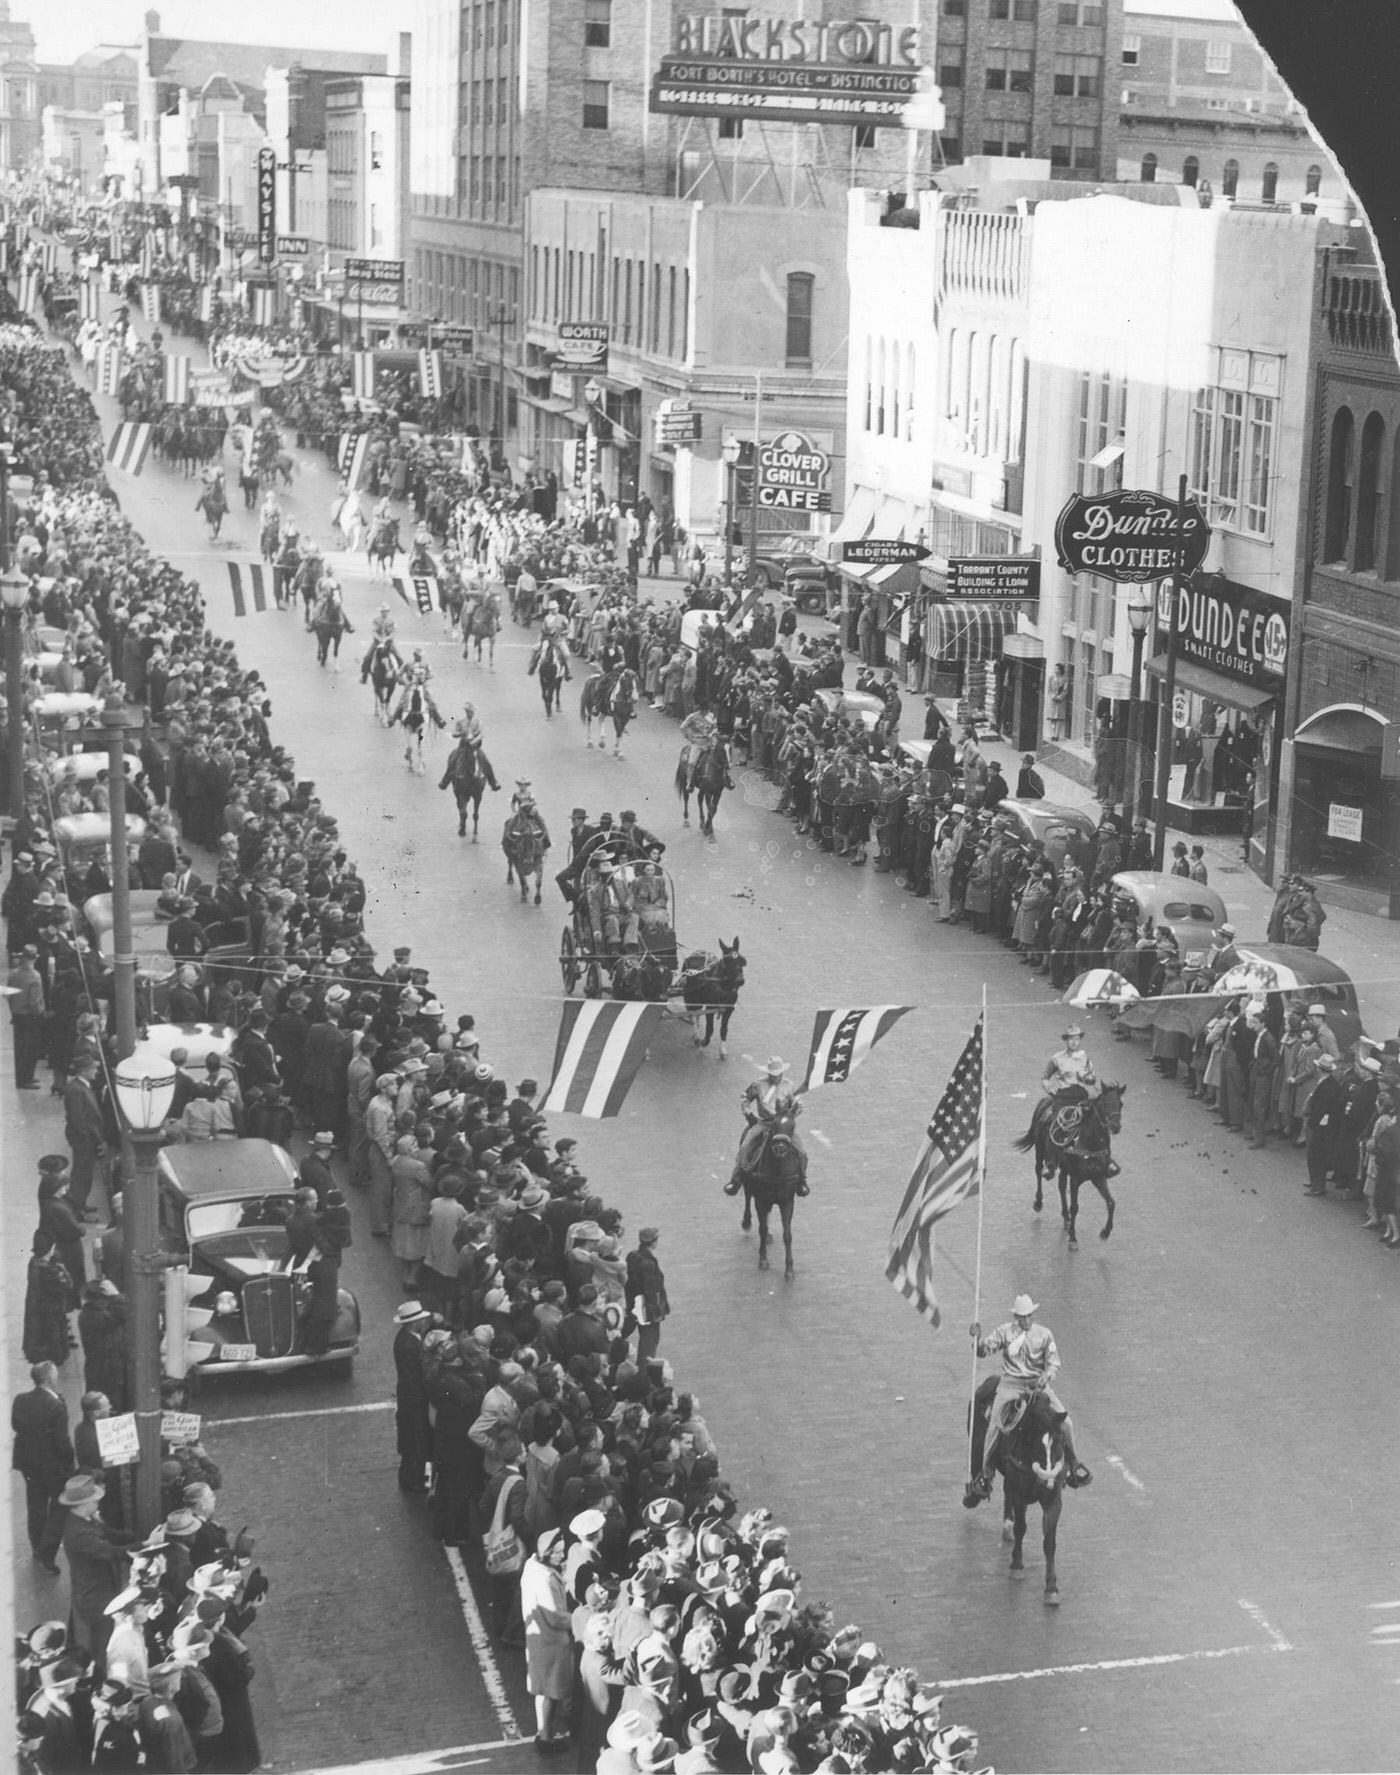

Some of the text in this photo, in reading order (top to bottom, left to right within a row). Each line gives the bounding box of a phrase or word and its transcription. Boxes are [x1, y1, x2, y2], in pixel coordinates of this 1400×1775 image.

[677, 17, 918, 65] BLACKSTONE
[670, 66, 703, 80] FORT
[767, 70, 813, 87] HOTEL
[278, 239, 306, 252] INN
[562, 326, 607, 339] WORTH
[563, 341, 594, 349] CAFE
[762, 451, 821, 470] CLOVER
[766, 468, 816, 486] GRILL
[760, 487, 820, 509] CAFE
[847, 548, 917, 557] LEDERMAN
[1178, 587, 1265, 662] DUNDEE
[1184, 638, 1254, 676] SMART CLOTHES
[1342, 808, 1361, 820] LEASE
